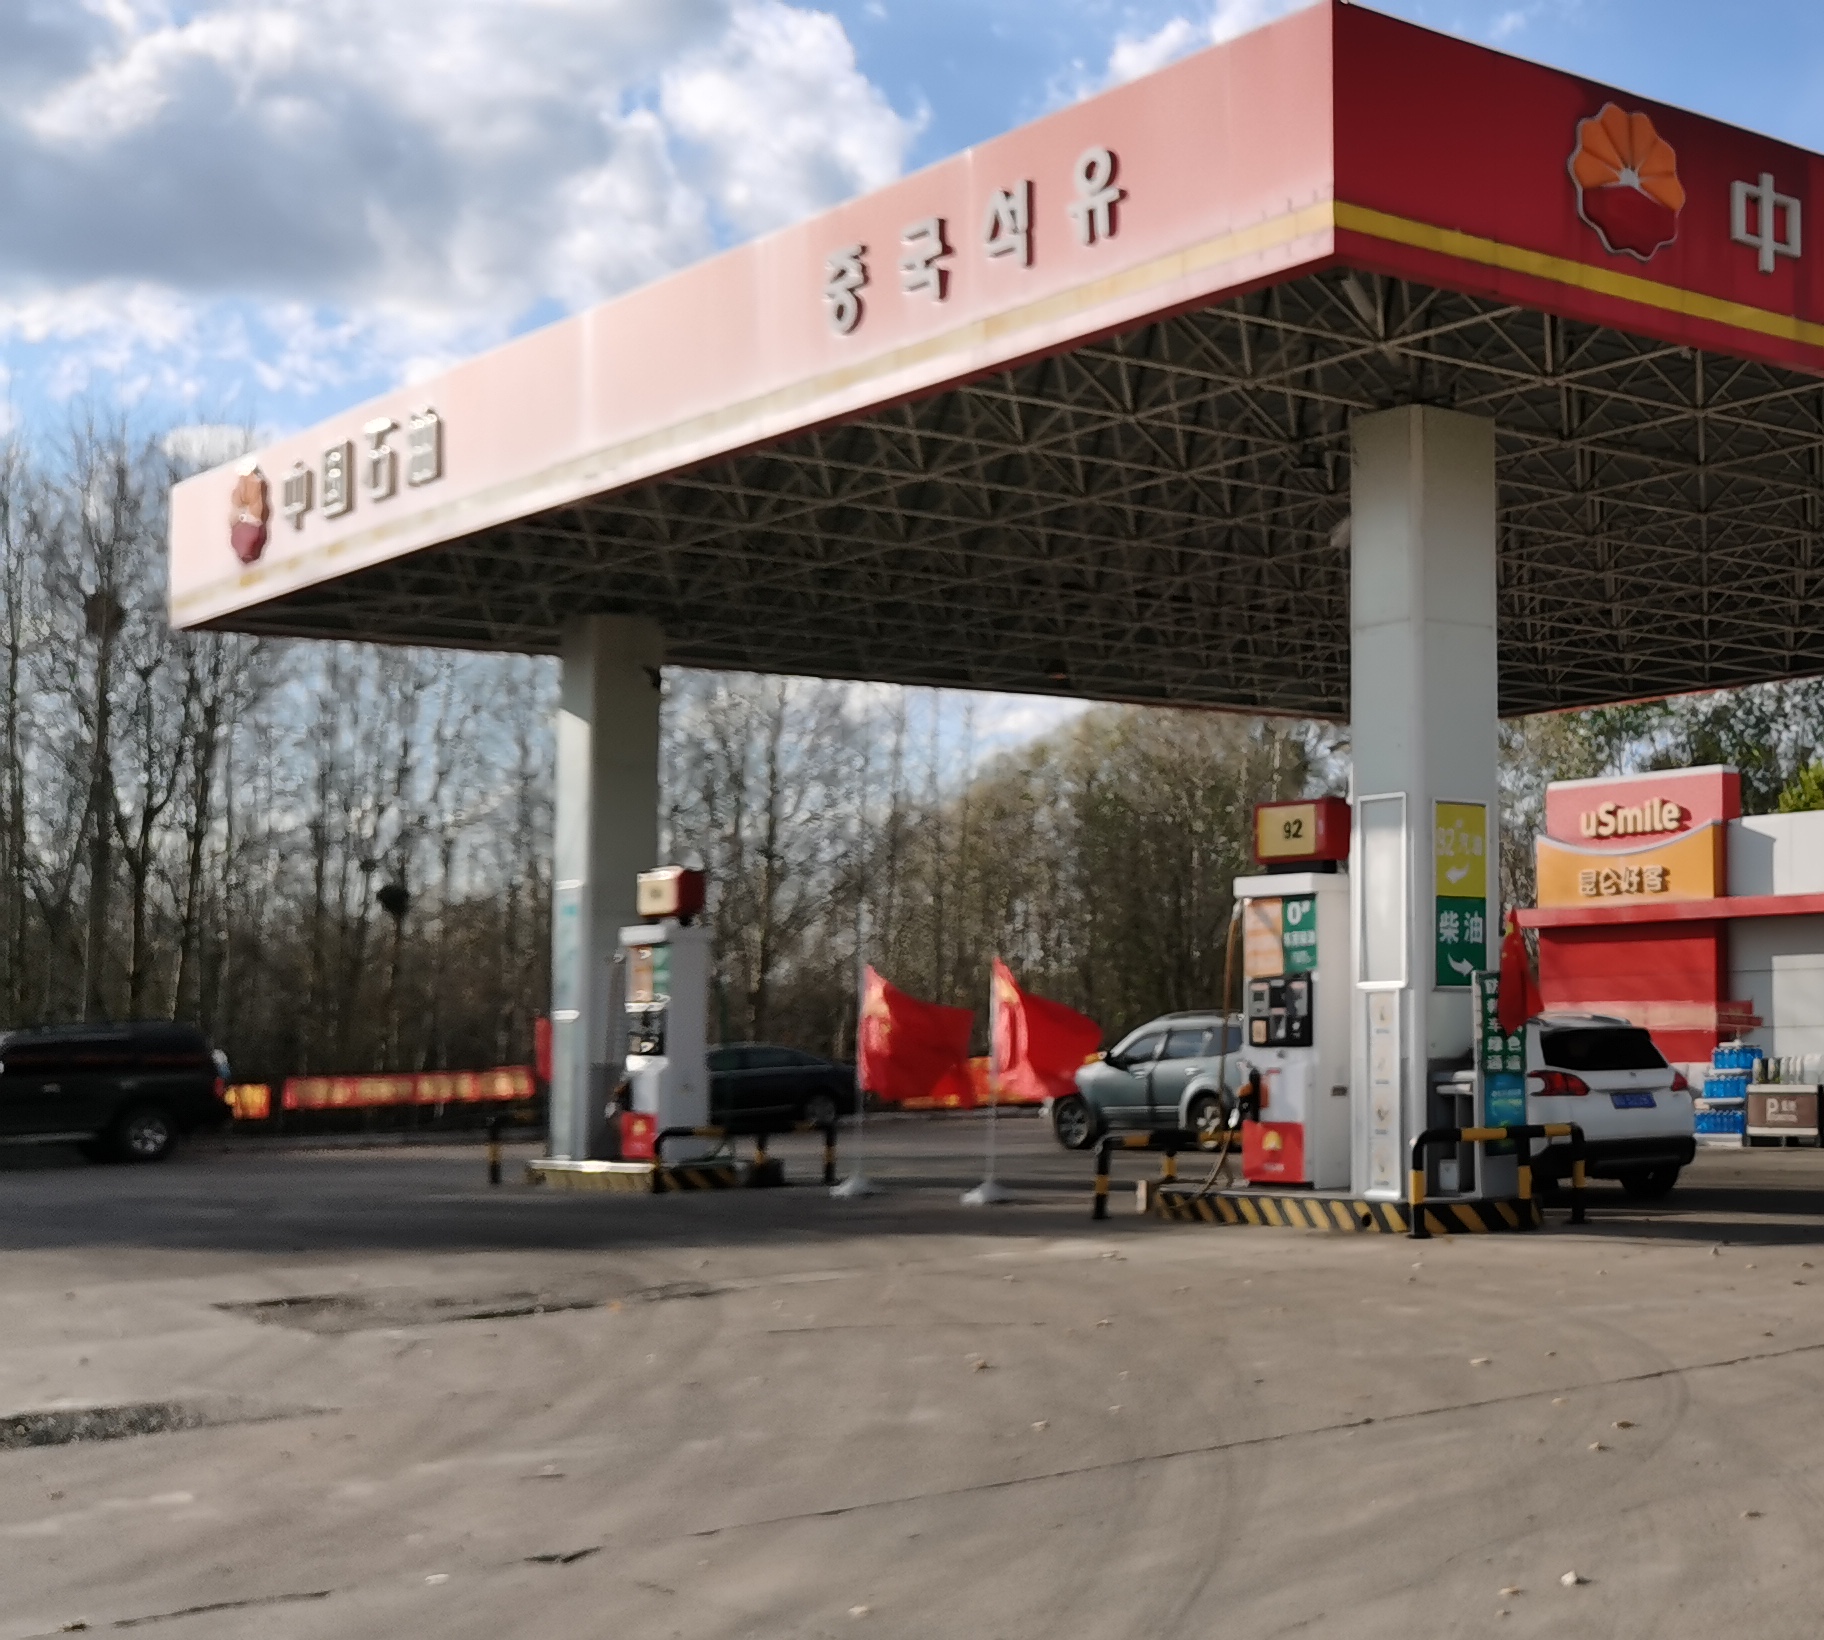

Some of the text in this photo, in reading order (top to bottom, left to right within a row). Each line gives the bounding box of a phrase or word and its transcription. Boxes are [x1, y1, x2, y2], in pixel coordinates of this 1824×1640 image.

[822, 147, 1128, 336] 중국석유
[1283, 819, 1303, 839] 92
[1580, 797, 1681, 838] uSmile
[1439, 911, 1483, 944] 柴油
